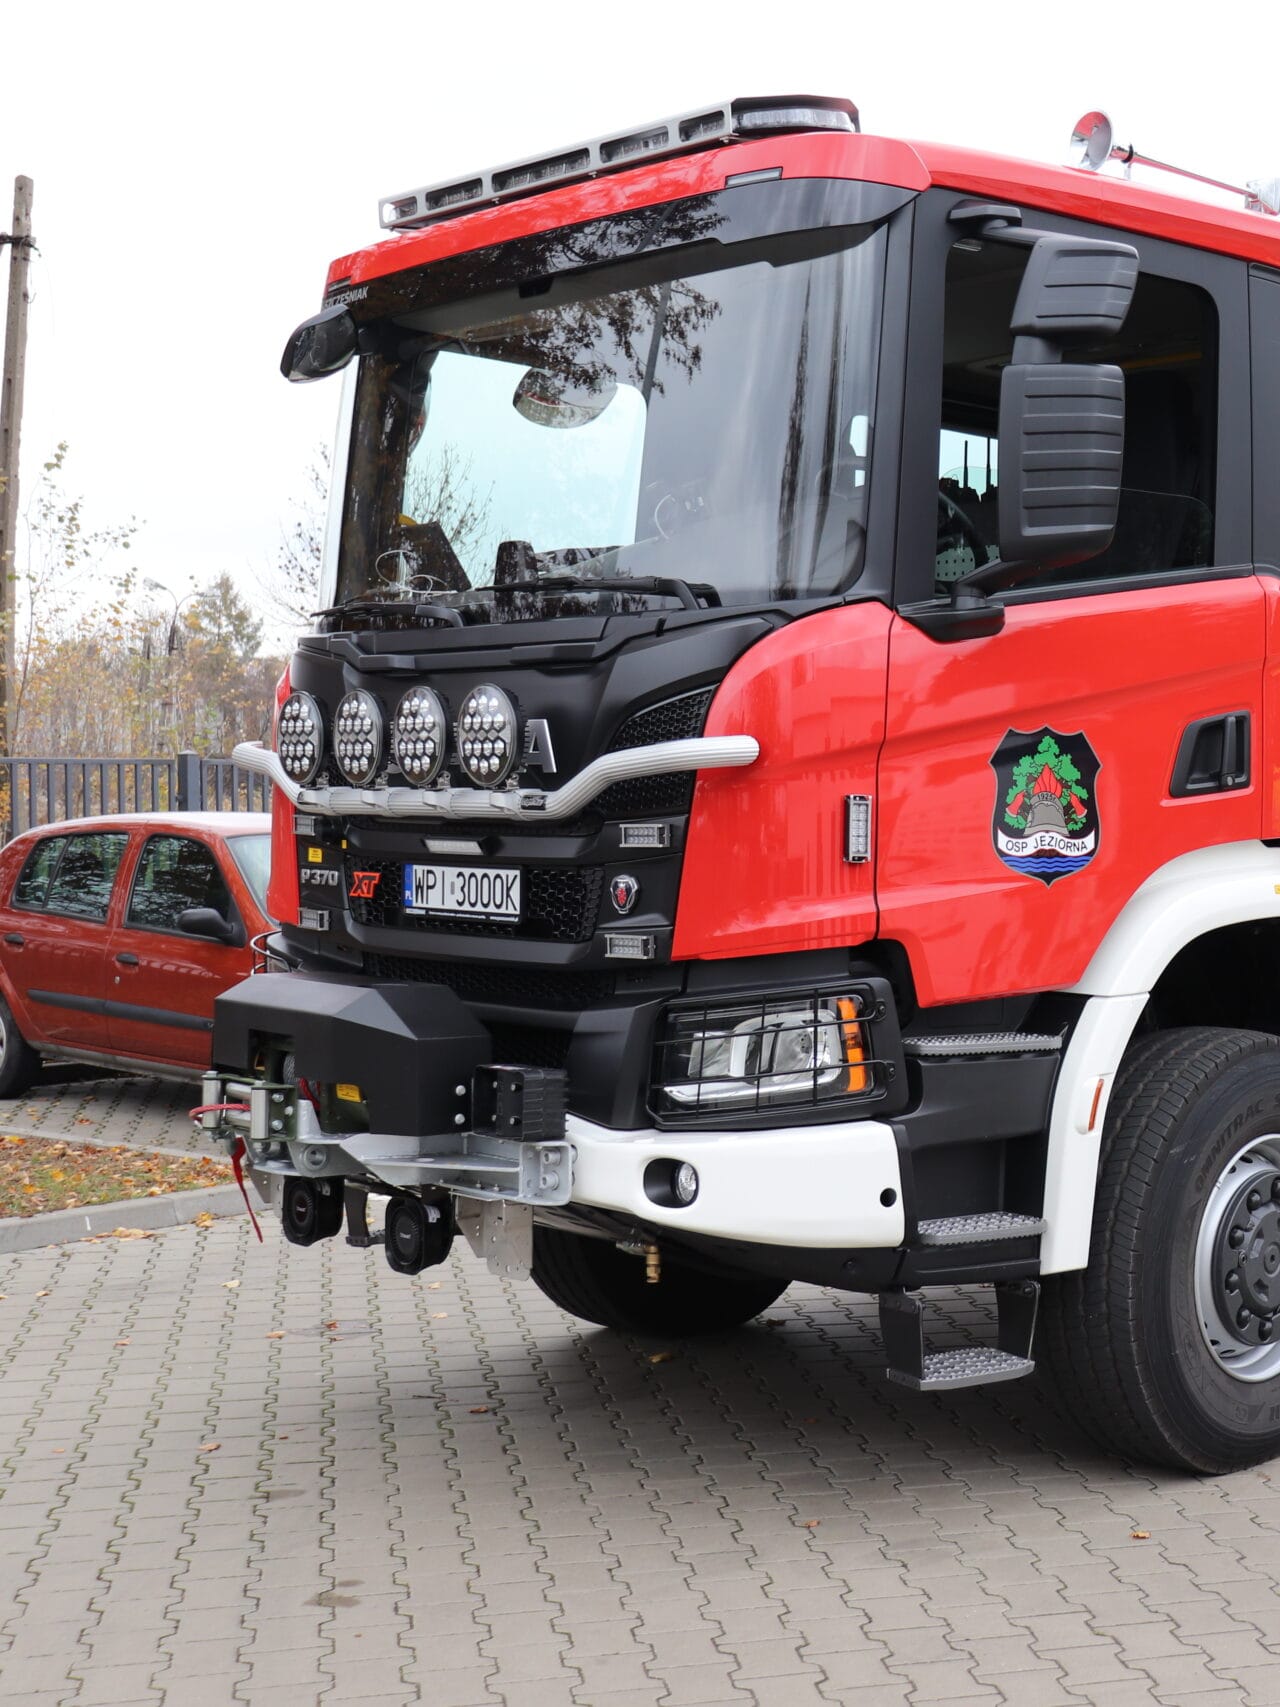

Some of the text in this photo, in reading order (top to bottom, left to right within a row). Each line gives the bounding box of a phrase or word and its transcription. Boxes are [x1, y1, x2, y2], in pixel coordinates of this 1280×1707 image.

[1006, 835, 1088, 852] OSP JEZIORNA
[349, 871, 381, 898] XT
[405, 890, 413, 900] PL
[415, 869, 518, 912] WPI 3000K
